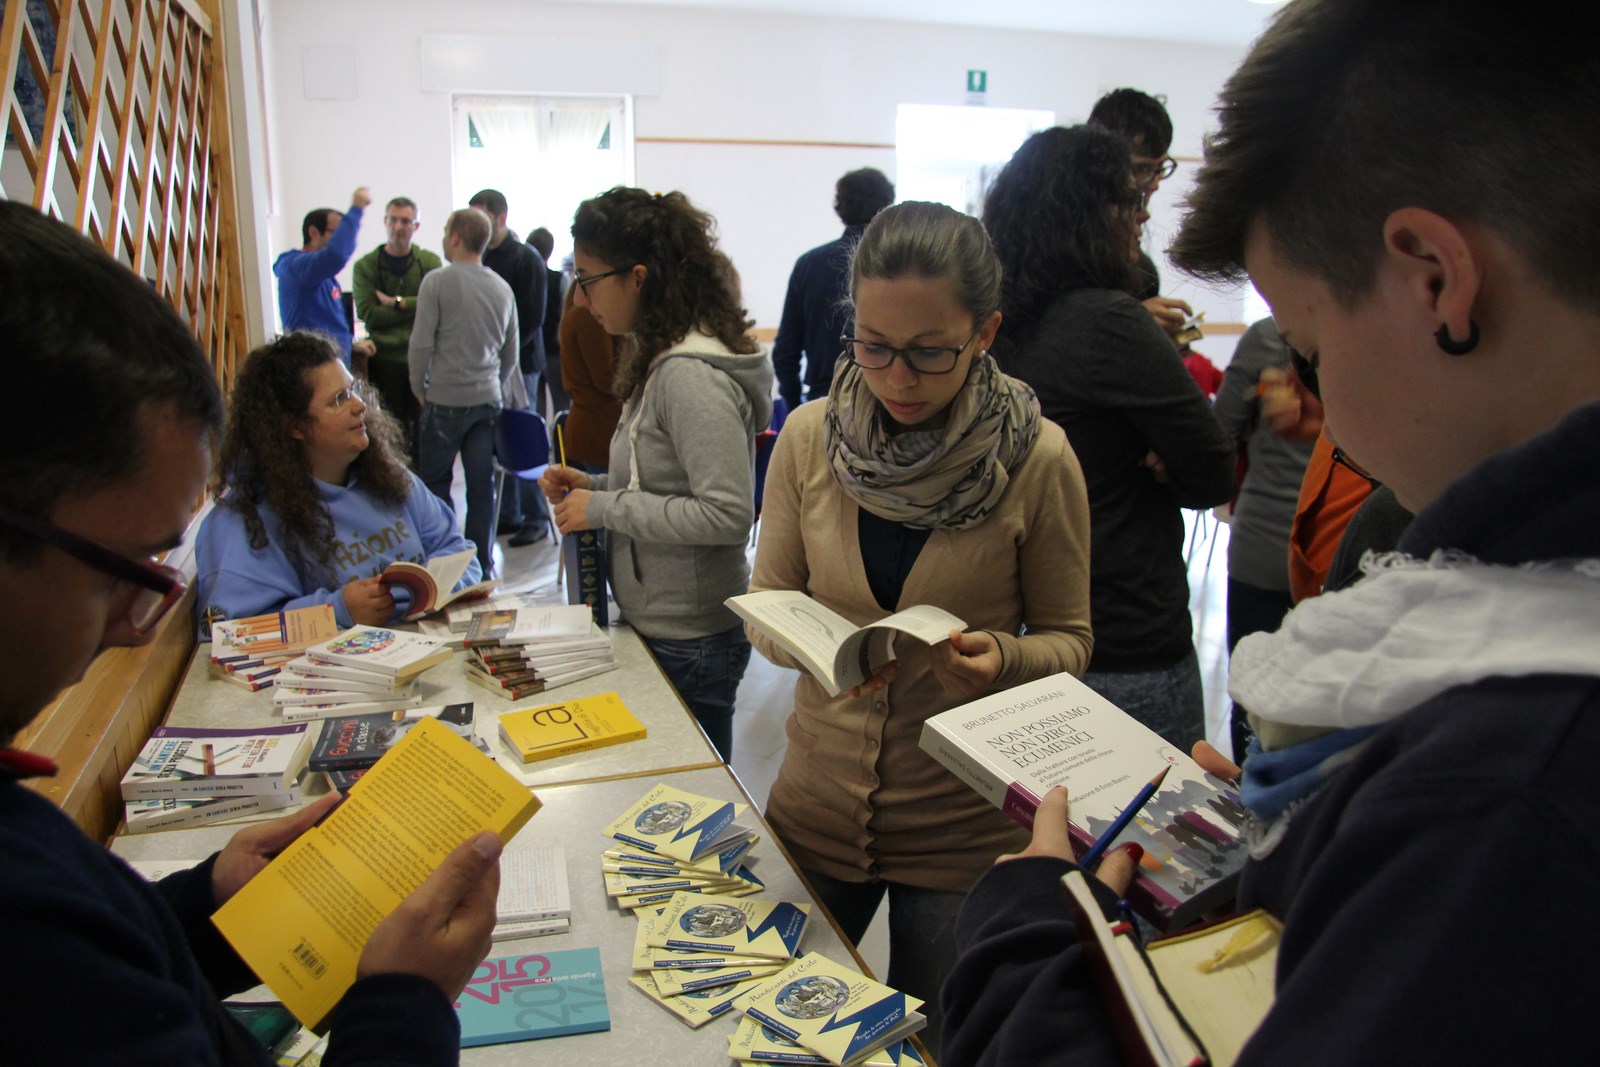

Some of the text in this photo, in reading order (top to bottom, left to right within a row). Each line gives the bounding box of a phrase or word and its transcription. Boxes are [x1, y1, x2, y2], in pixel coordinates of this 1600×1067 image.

[331, 520, 410, 571] Azione
[963, 689, 1066, 731] BRUNETTO SALVARANI
[328, 719, 359, 757] Guccini
[353, 721, 370, 752] in classe
[986, 705, 1090, 749] NON POSSIAMO
[999, 723, 1077, 758] NON DIRCI
[170, 740, 194, 764] PROGETTO
[1012, 731, 1095, 768] ECUMENICI
[1043, 769, 1063, 780] futuro
[1062, 760, 1085, 772] comune
[1084, 754, 1098, 765] delle
[1096, 748, 1114, 759] chiese
[1030, 769, 1046, 778] Dalla
[1046, 758, 1068, 771] frattura
[229, 805, 241, 813] SENZA
[1067, 787, 1095, 805] Prefazione
[534, 971, 597, 984] Agenda della Pace
[749, 958, 818, 1005] Mendicanti del Cielo
